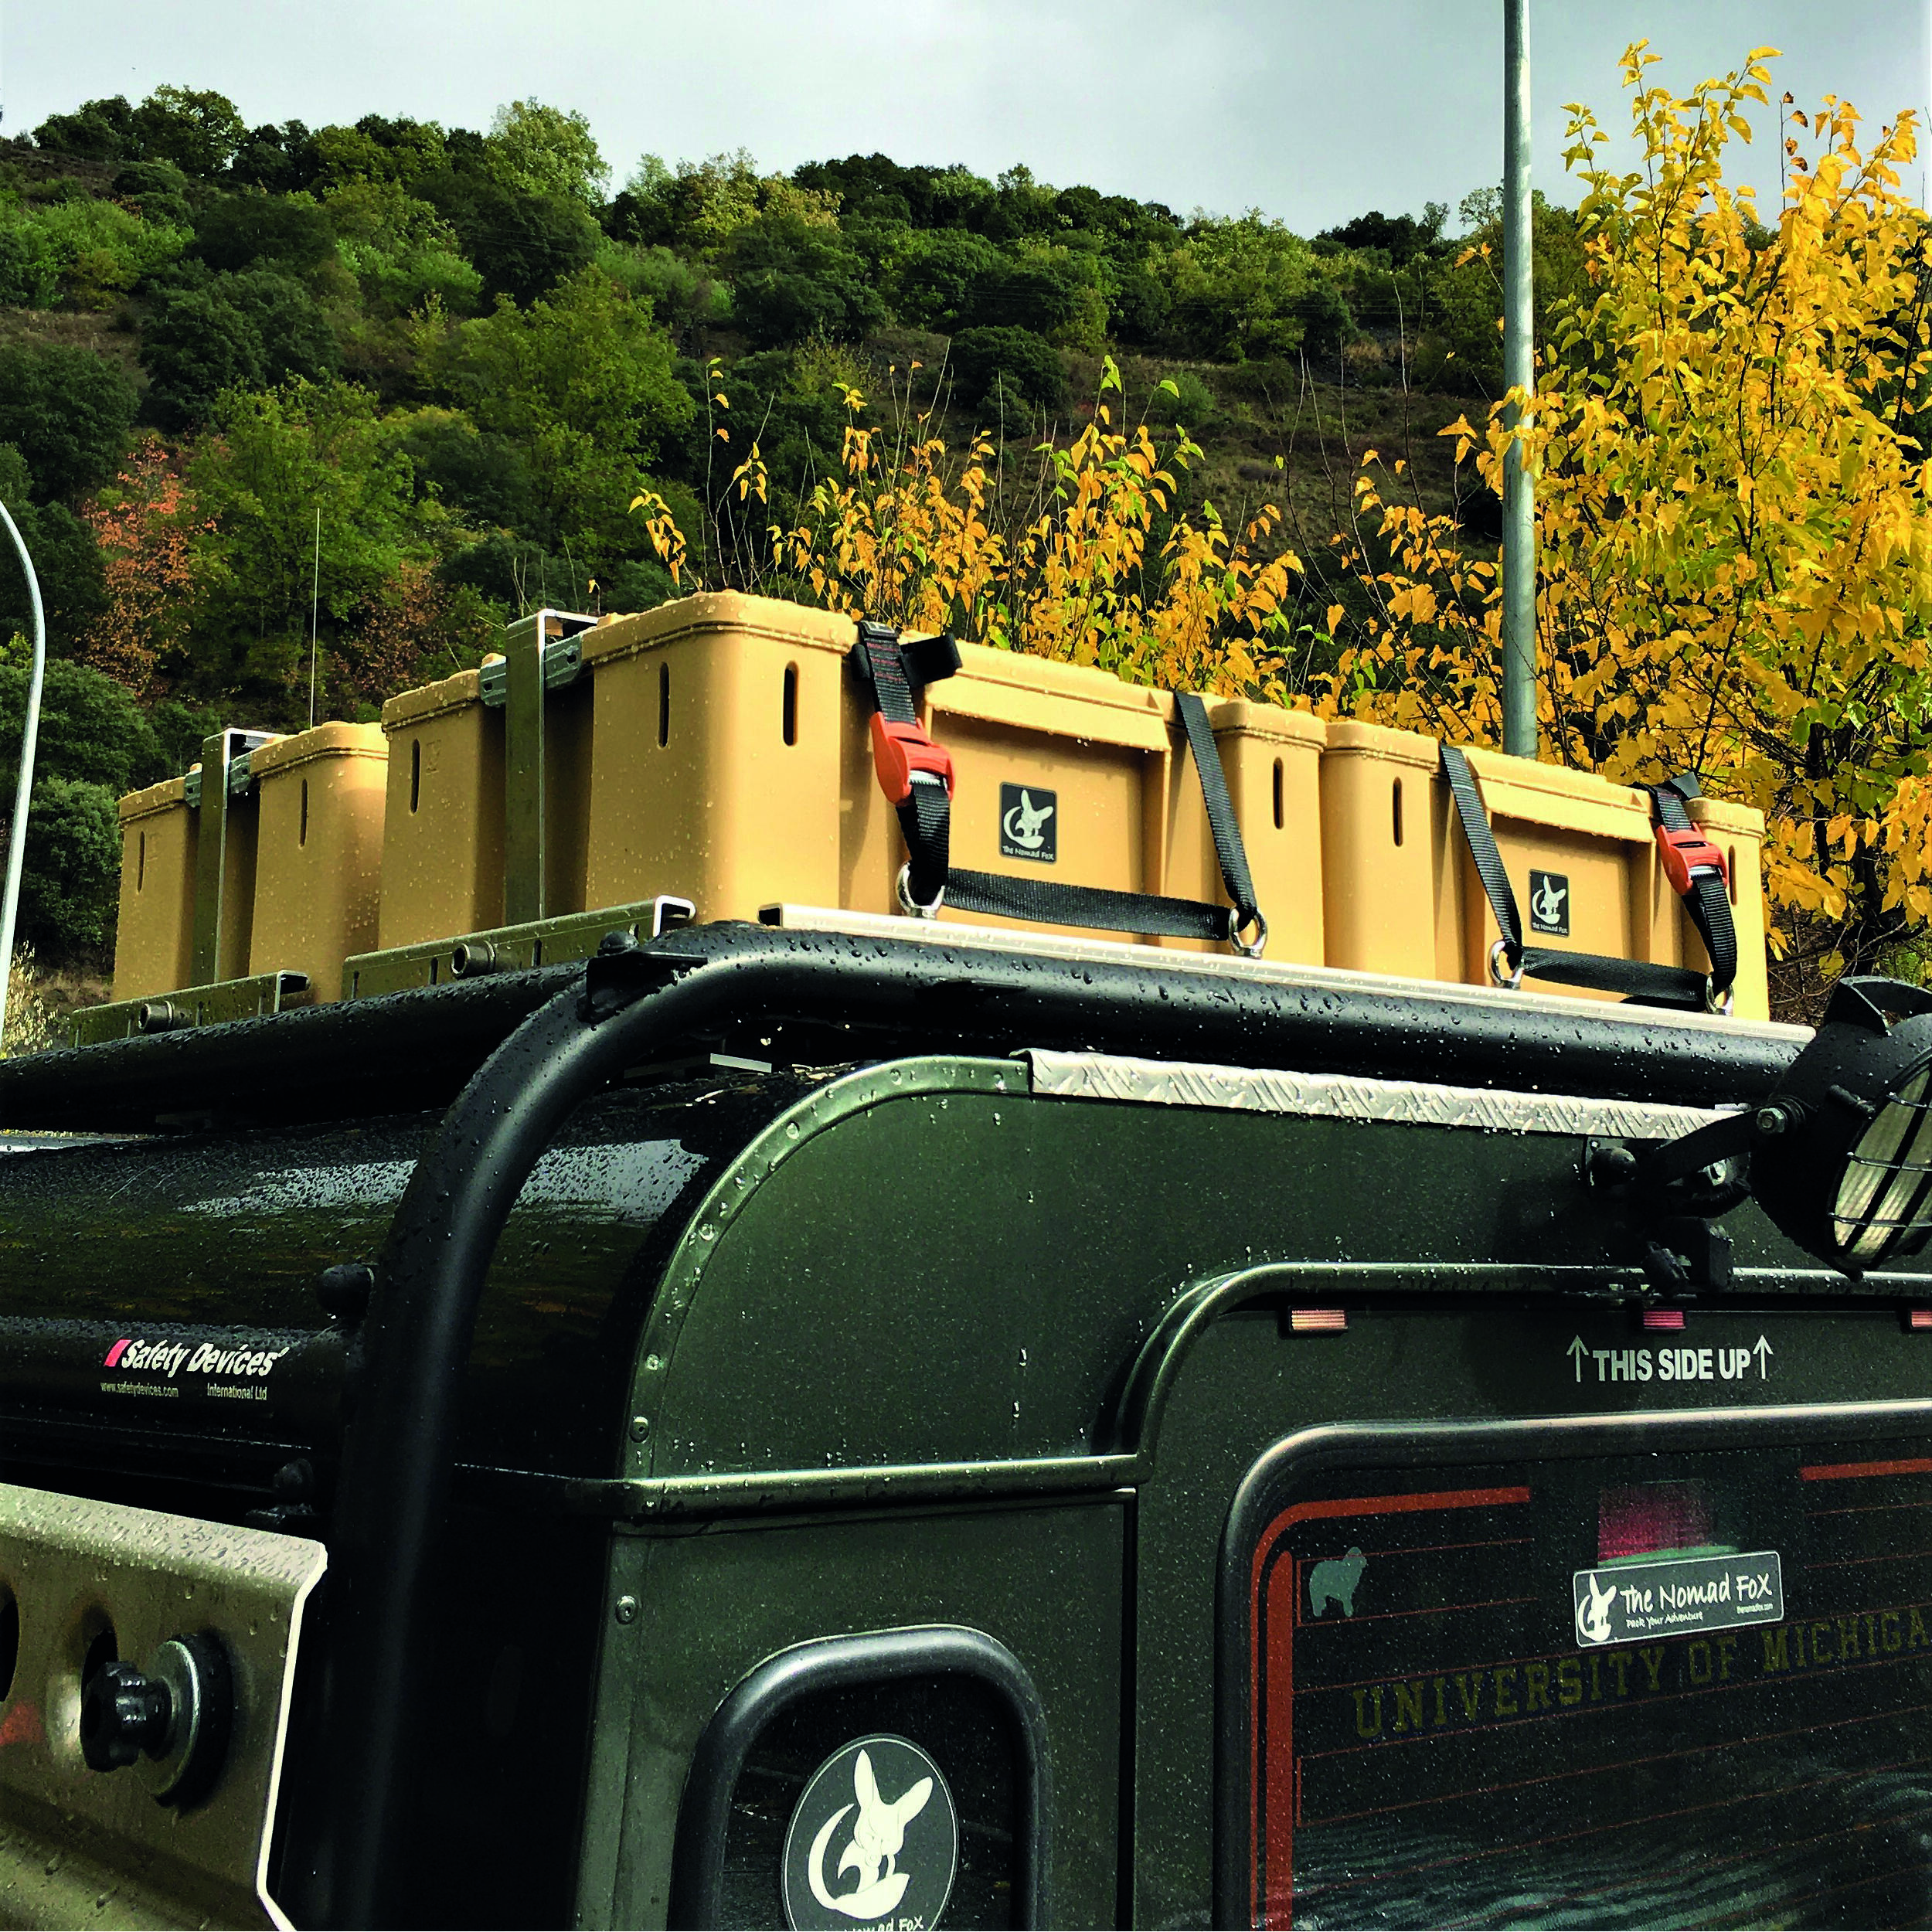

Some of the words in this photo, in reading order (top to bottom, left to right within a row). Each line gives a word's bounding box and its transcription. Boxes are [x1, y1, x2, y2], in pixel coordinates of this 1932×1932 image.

[121, 1339, 191, 1378] Safety
[186, 1342, 290, 1376] Devices
[1593, 1349, 1653, 1382] THIS
[1658, 1349, 1714, 1381] SIDE
[1719, 1349, 1750, 1379] UP
[207, 1383, 253, 1400] International
[254, 1386, 267, 1400] Ltd
[1620, 1584, 1654, 1614] The
[1659, 1571, 1731, 1611] Nomad
[1665, 1611, 1703, 1624] Adventure
[1353, 1646, 1666, 1738] UNIVERSITY
[1688, 1635, 1738, 1685] OF
